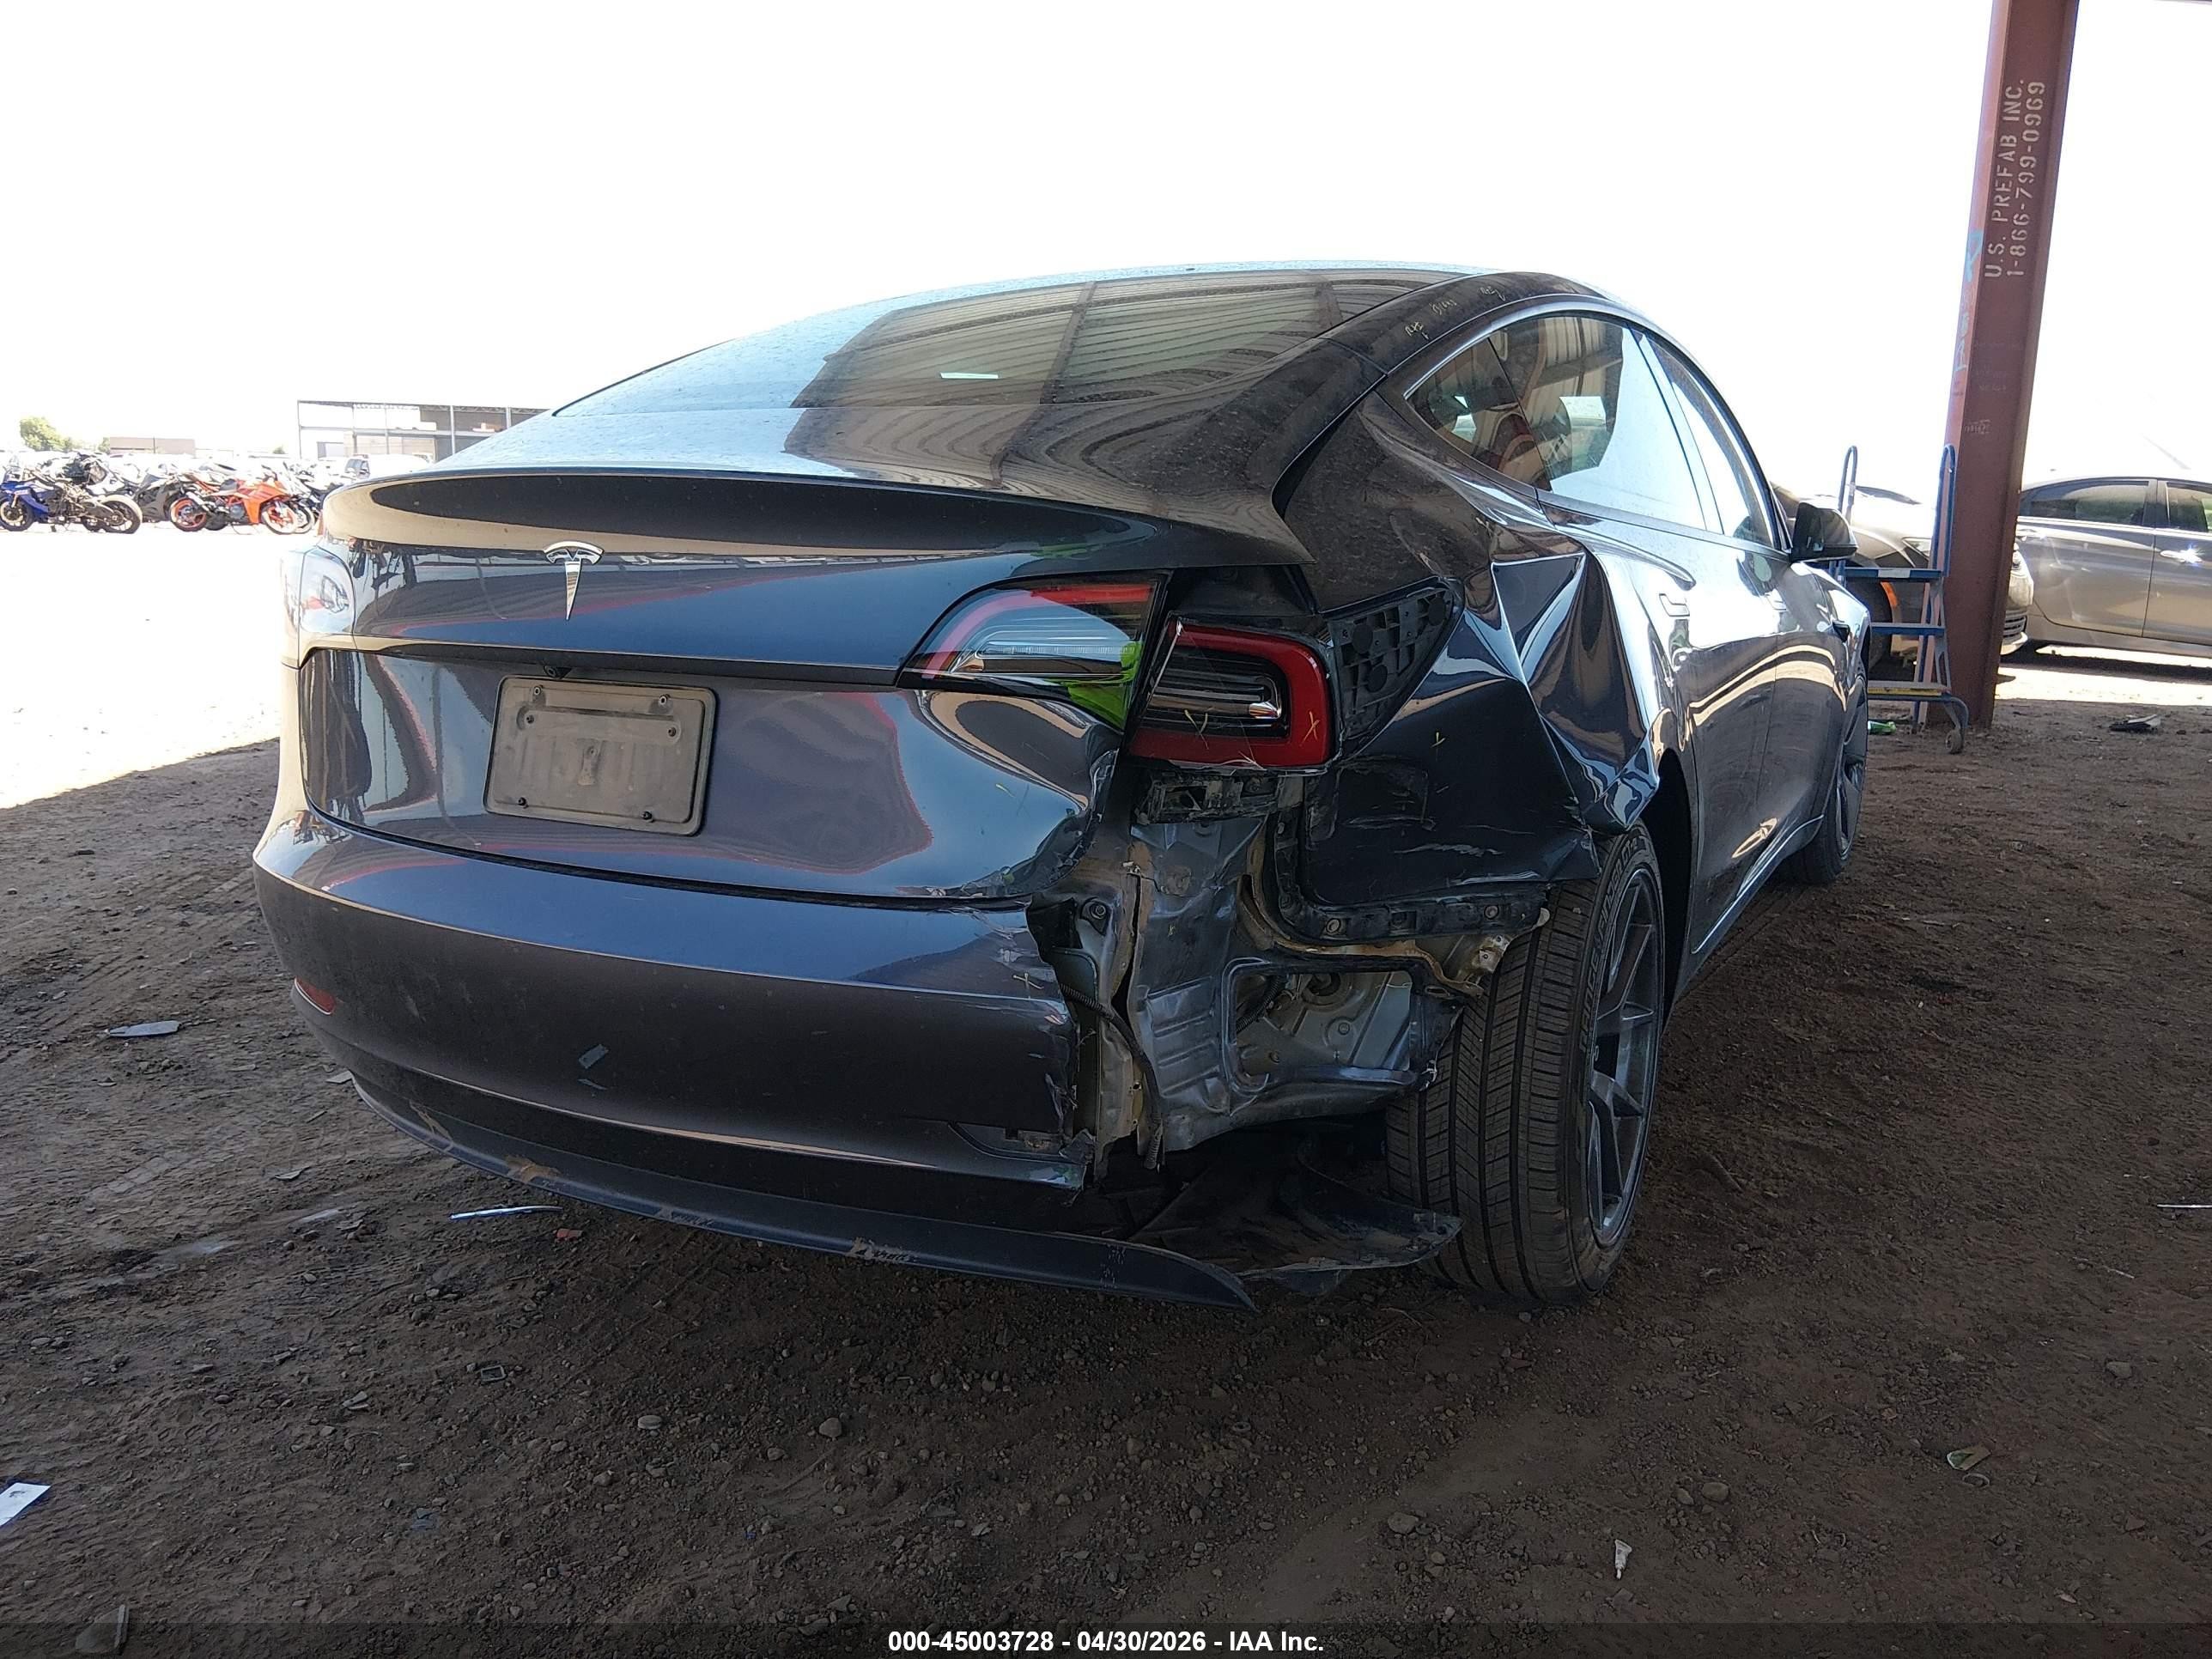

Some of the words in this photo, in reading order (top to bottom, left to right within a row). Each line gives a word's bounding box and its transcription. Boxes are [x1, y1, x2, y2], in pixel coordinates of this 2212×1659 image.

[2002, 79, 2024, 122] INC.
[1991, 134, 2018, 222] PREFAB
[2006, 81, 2045, 276] 1-866-799-0969
[1984, 236, 2007, 278] U.S.
